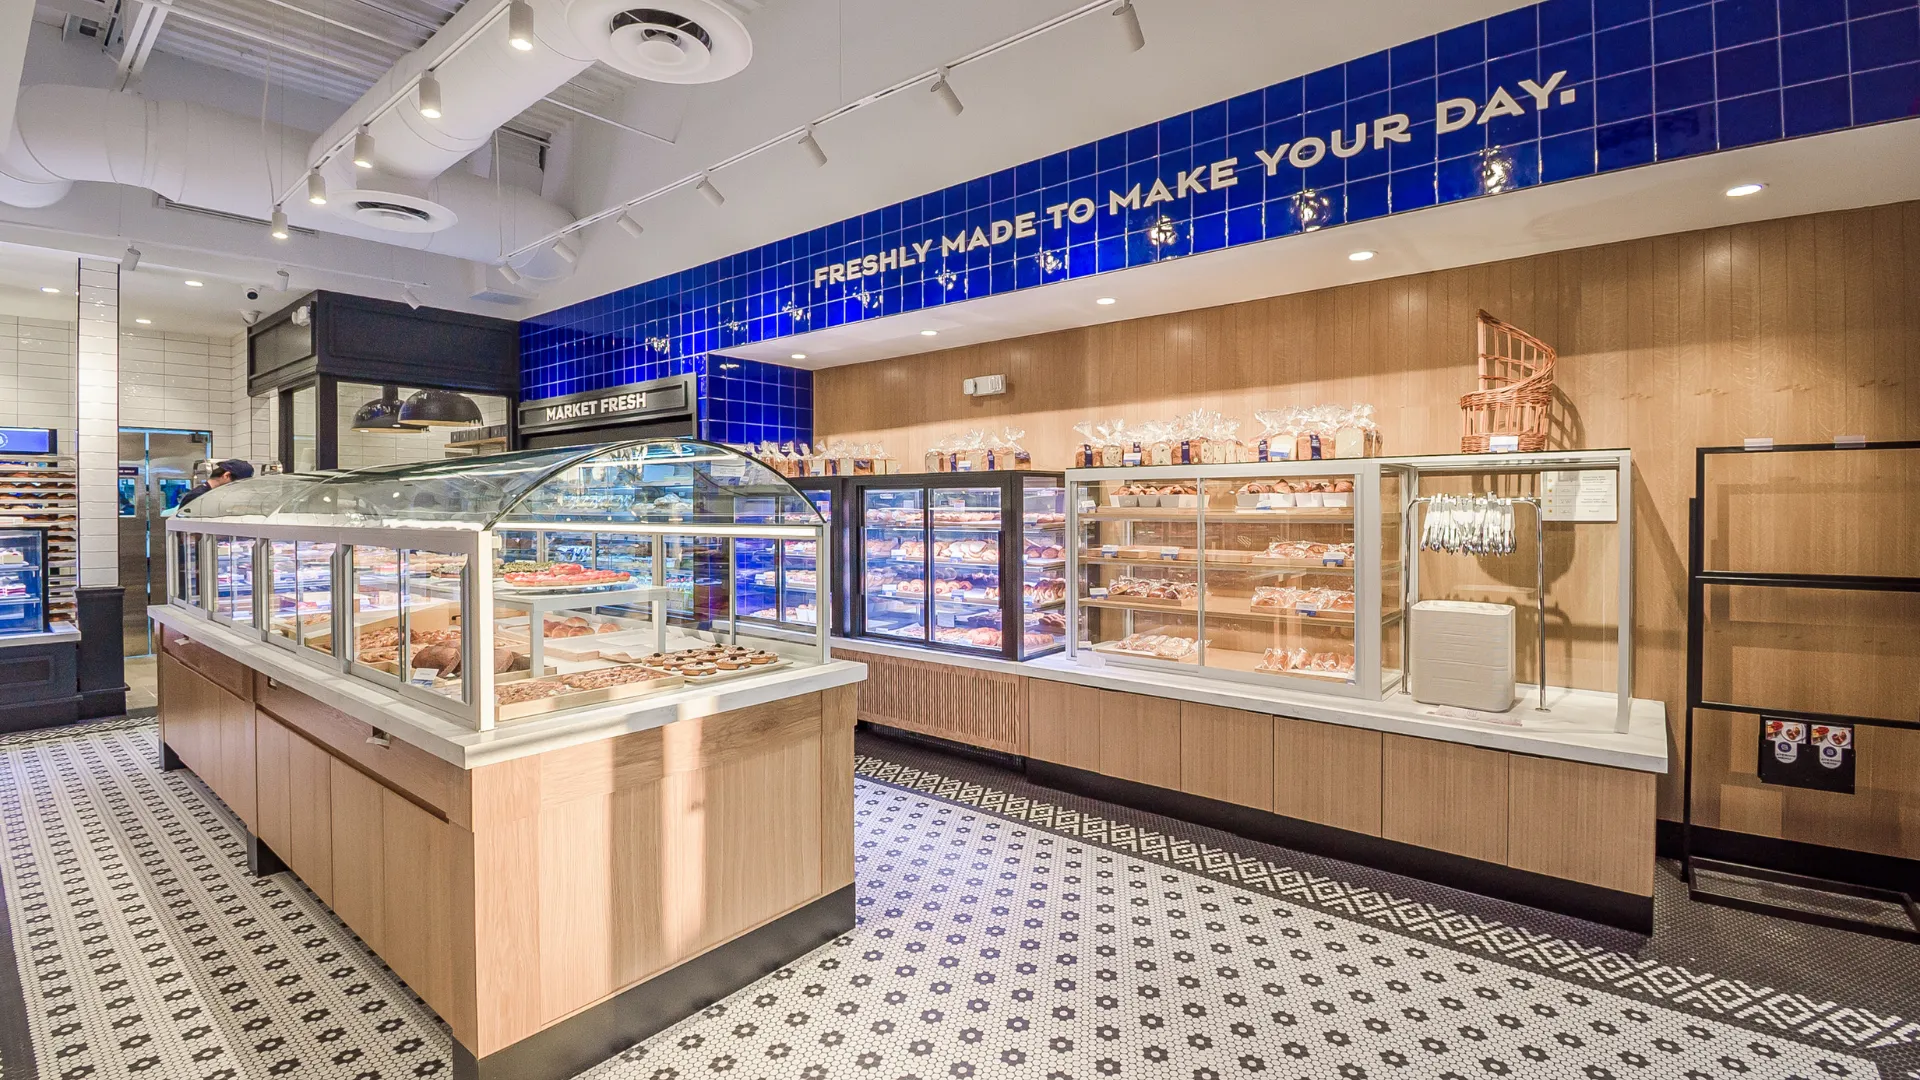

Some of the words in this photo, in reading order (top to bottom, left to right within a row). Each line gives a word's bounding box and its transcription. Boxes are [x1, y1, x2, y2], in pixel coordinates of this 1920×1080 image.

[814, 239, 933, 288] FRESHLY
[941, 211, 1036, 257] MADE
[1046, 198, 1095, 229] TO
[1109, 157, 1238, 215] MAKE
[1255, 113, 1411, 176] YOUR
[1436, 70, 1576, 134] DAY.
[546, 401, 597, 422] MARKET
[600, 392, 647, 413] FRESH
